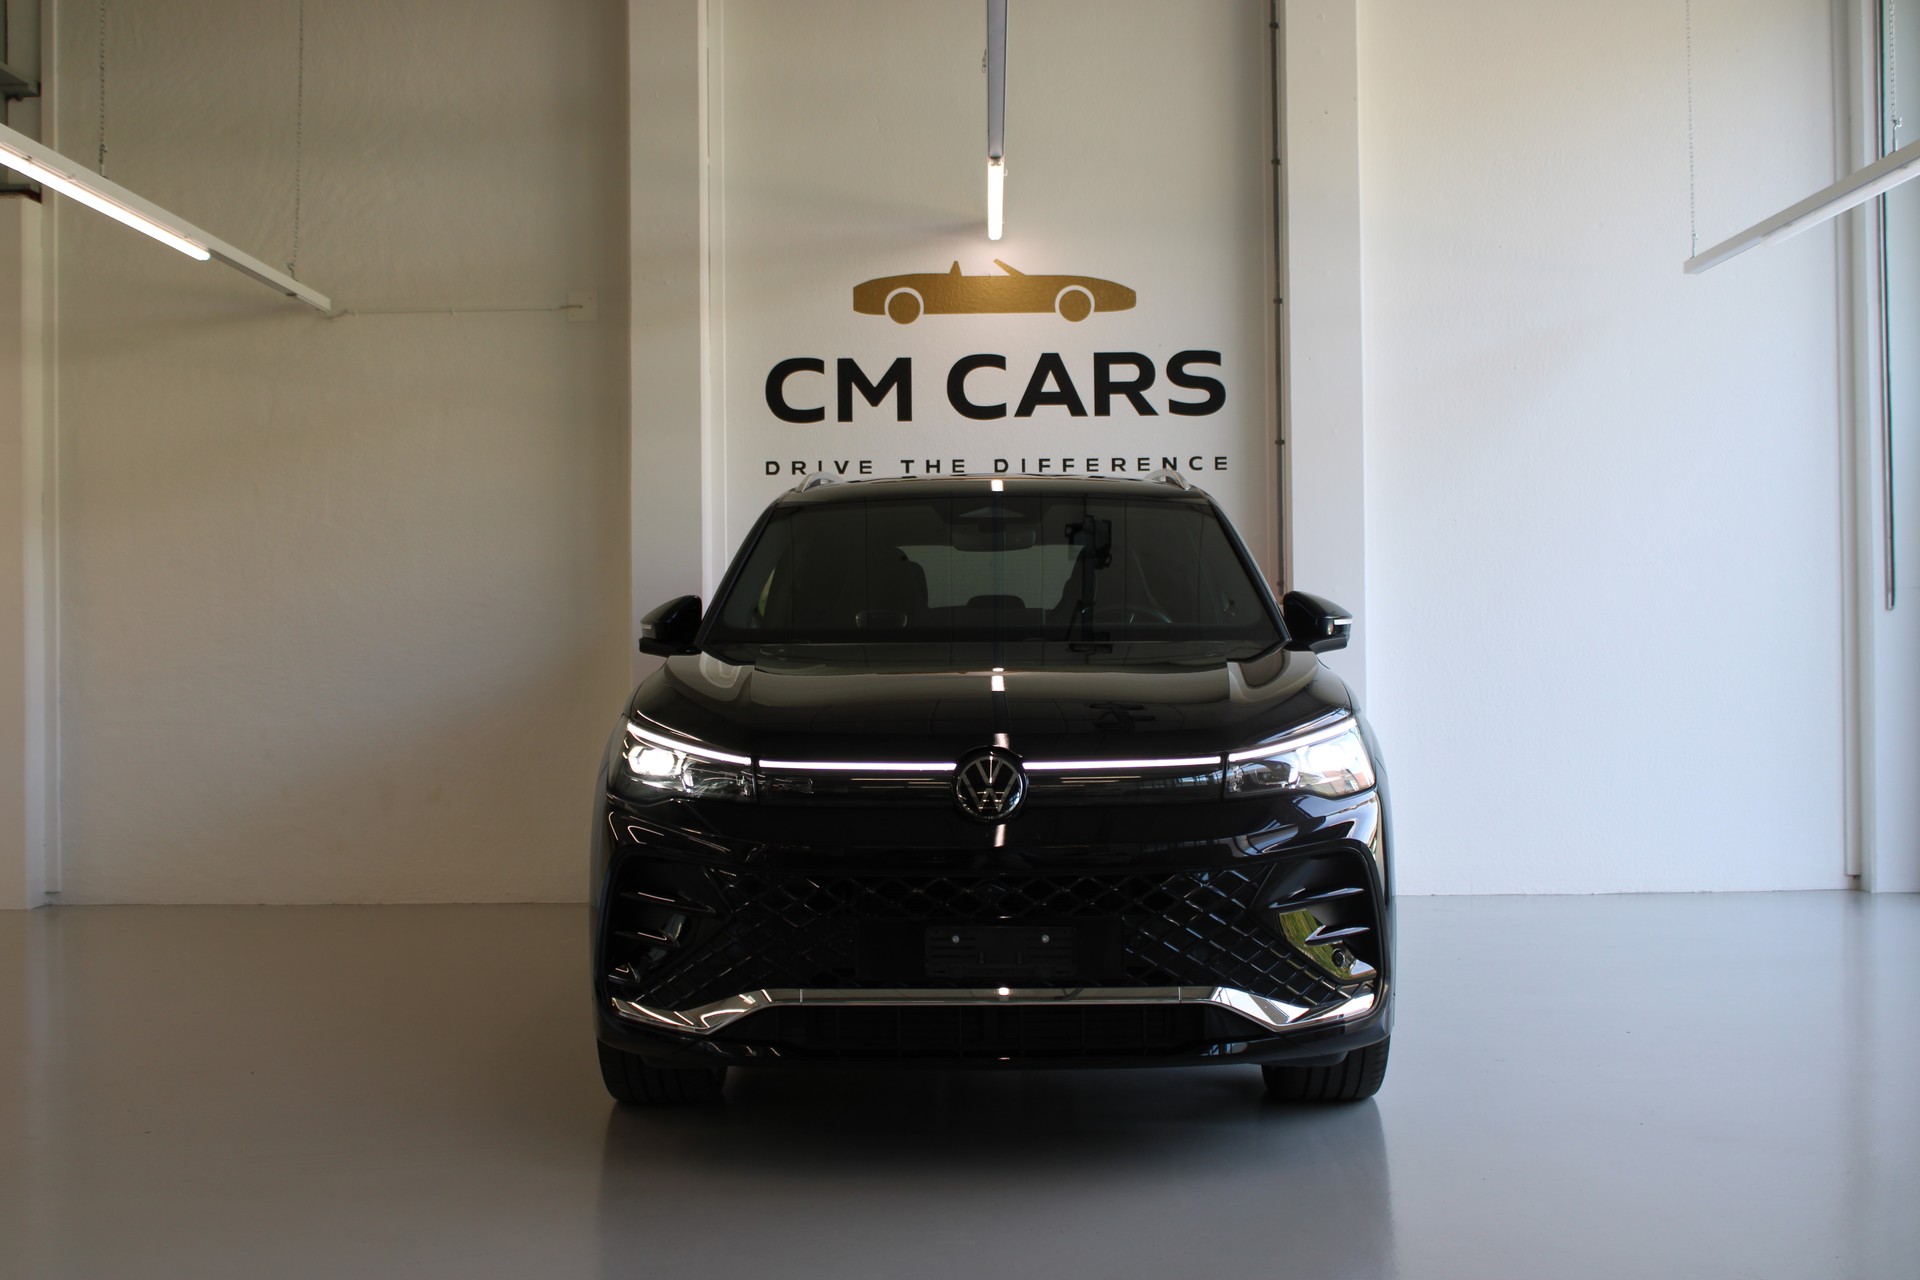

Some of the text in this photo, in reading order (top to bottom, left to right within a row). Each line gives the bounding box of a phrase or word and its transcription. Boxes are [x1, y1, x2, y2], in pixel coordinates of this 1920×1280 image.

[765, 350, 1227, 423] CM CARS
[766, 456, 1228, 476] DRIVE THE DIFFERENCE
